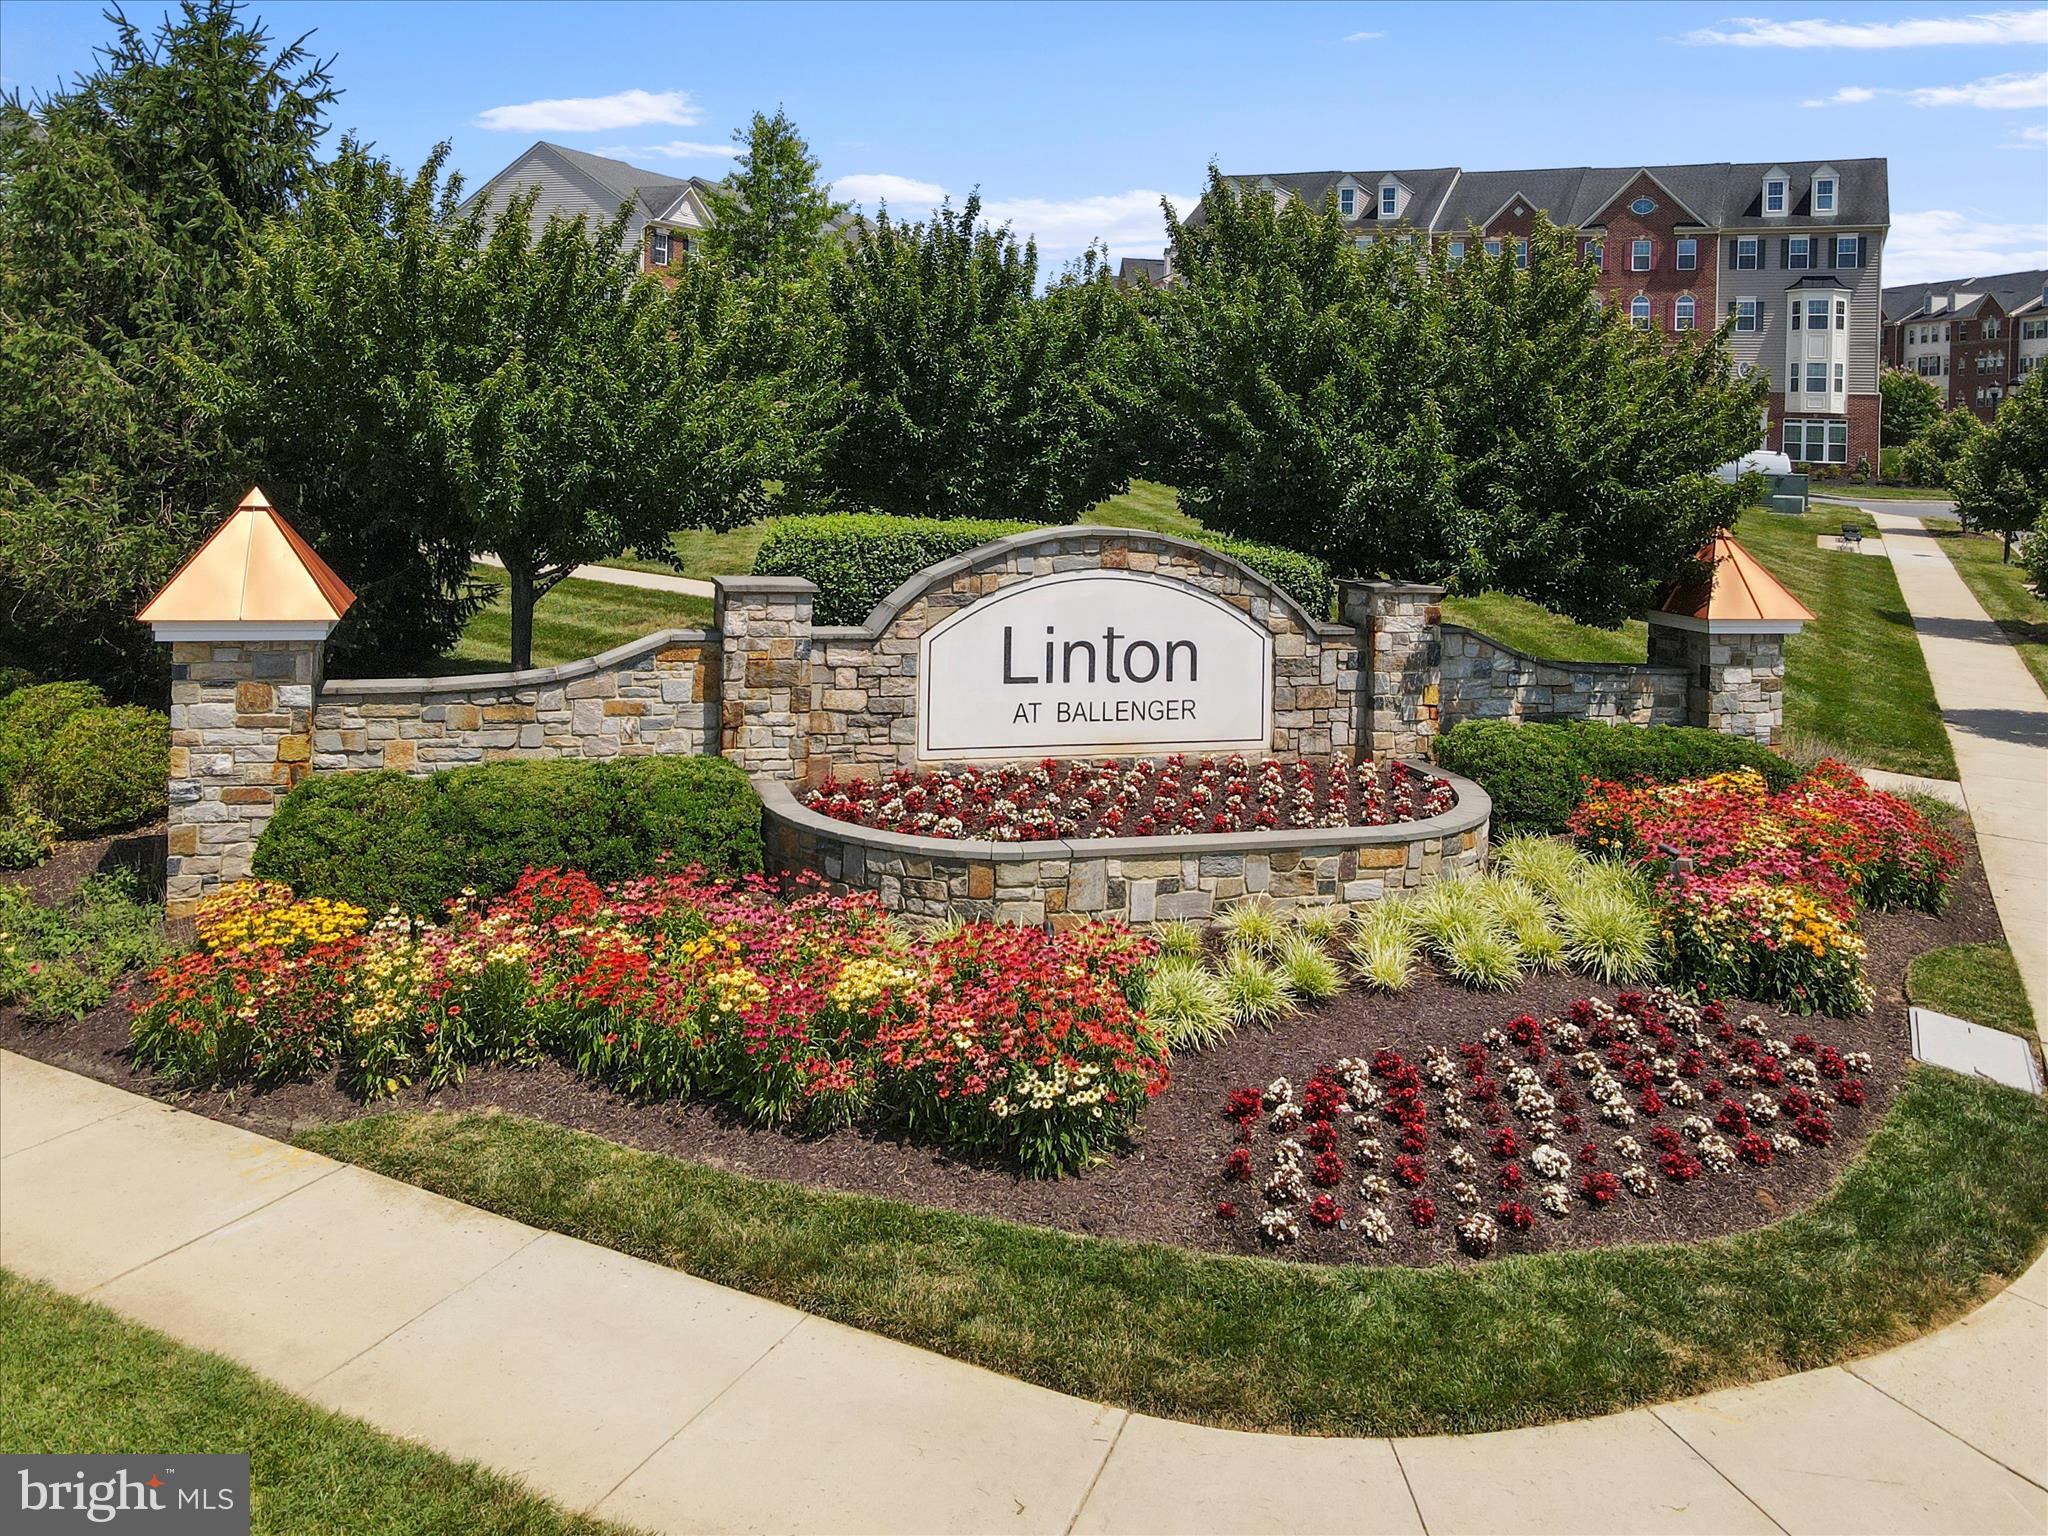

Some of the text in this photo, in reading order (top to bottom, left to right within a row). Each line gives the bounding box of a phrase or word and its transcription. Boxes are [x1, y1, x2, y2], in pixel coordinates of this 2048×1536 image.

[1003, 625, 1198, 684] Linton
[1012, 699, 1197, 724] AT BALLENGER
